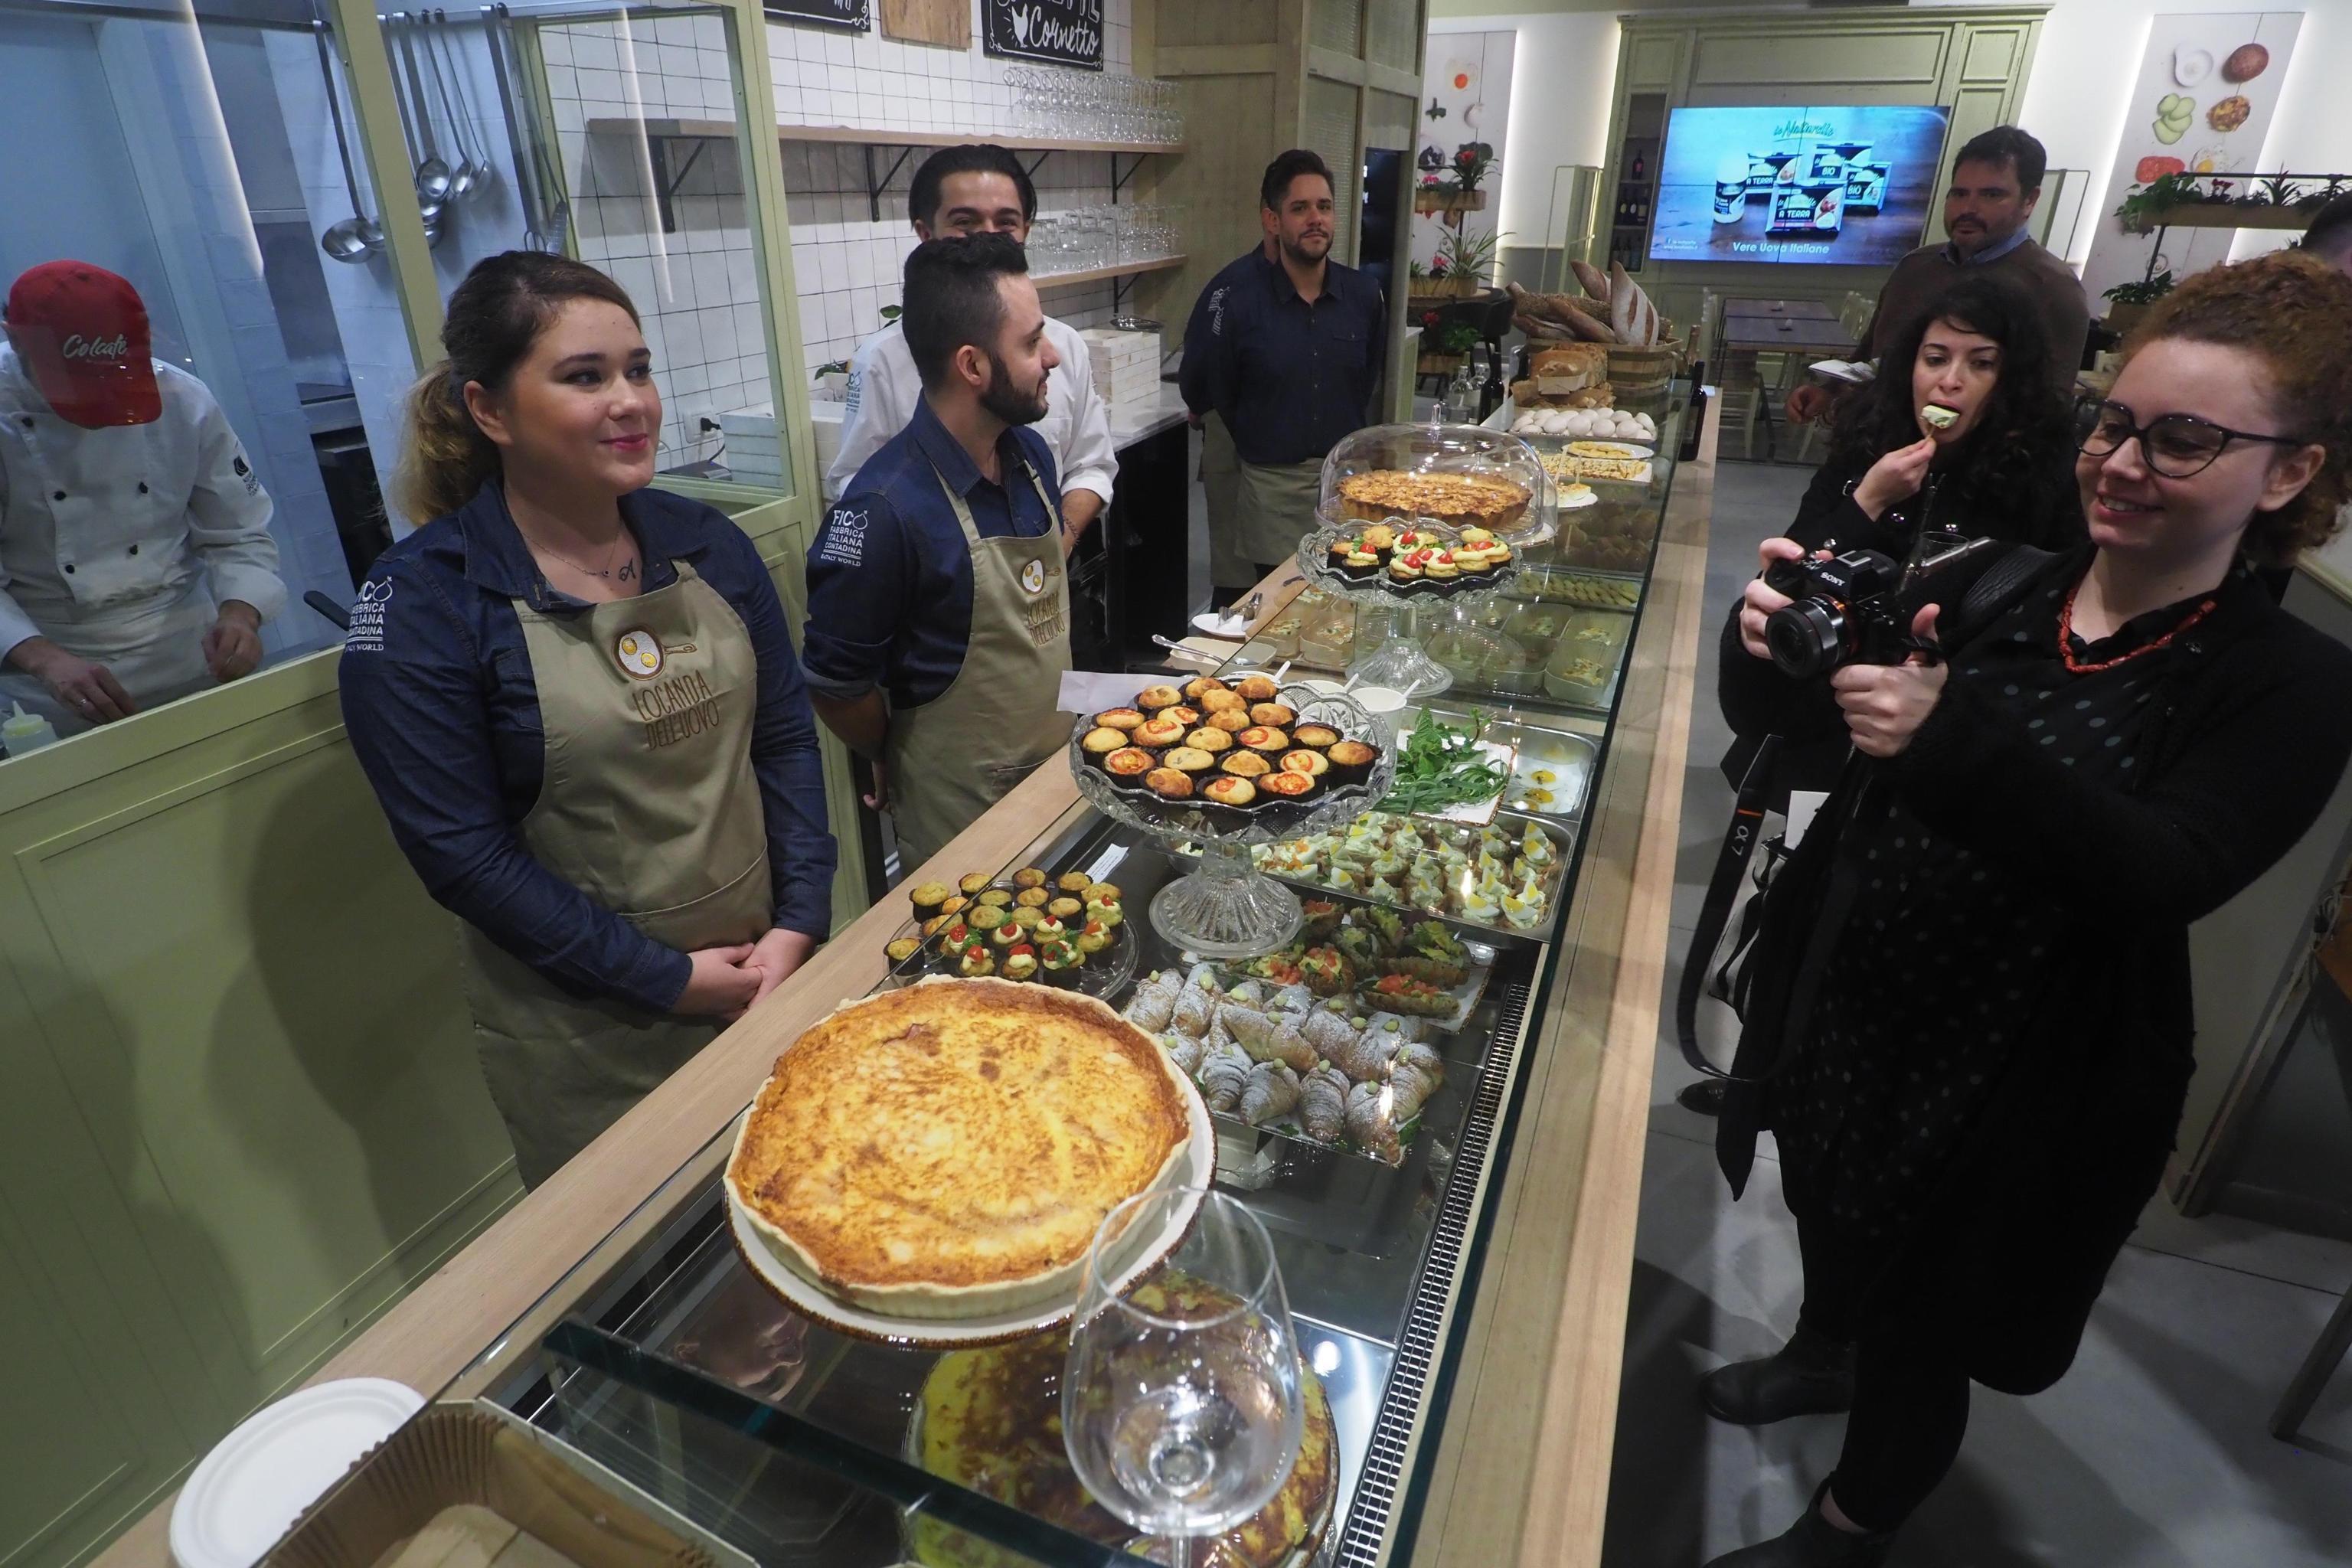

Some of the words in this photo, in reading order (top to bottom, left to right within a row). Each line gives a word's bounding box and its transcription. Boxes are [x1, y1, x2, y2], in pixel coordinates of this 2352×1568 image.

[1029, 5, 1099, 56] Cornetto
[1821, 167, 1836, 176] BIO
[1847, 185, 1862, 195] BIO
[1787, 210, 1811, 219] TERRA
[1733, 242, 1757, 252] Vere
[1759, 243, 1788, 253] Uova
[1789, 243, 1830, 254] Italiane
[829, 525, 864, 540] FABBRICA
[827, 534, 863, 548] ITALIANA
[825, 541, 862, 556] CONTADINA
[838, 557, 861, 567] WORLD
[1820, 571, 1846, 587] SONY
[357, 643, 384, 652] WORLD
[632, 669, 713, 722] LOCANDA
